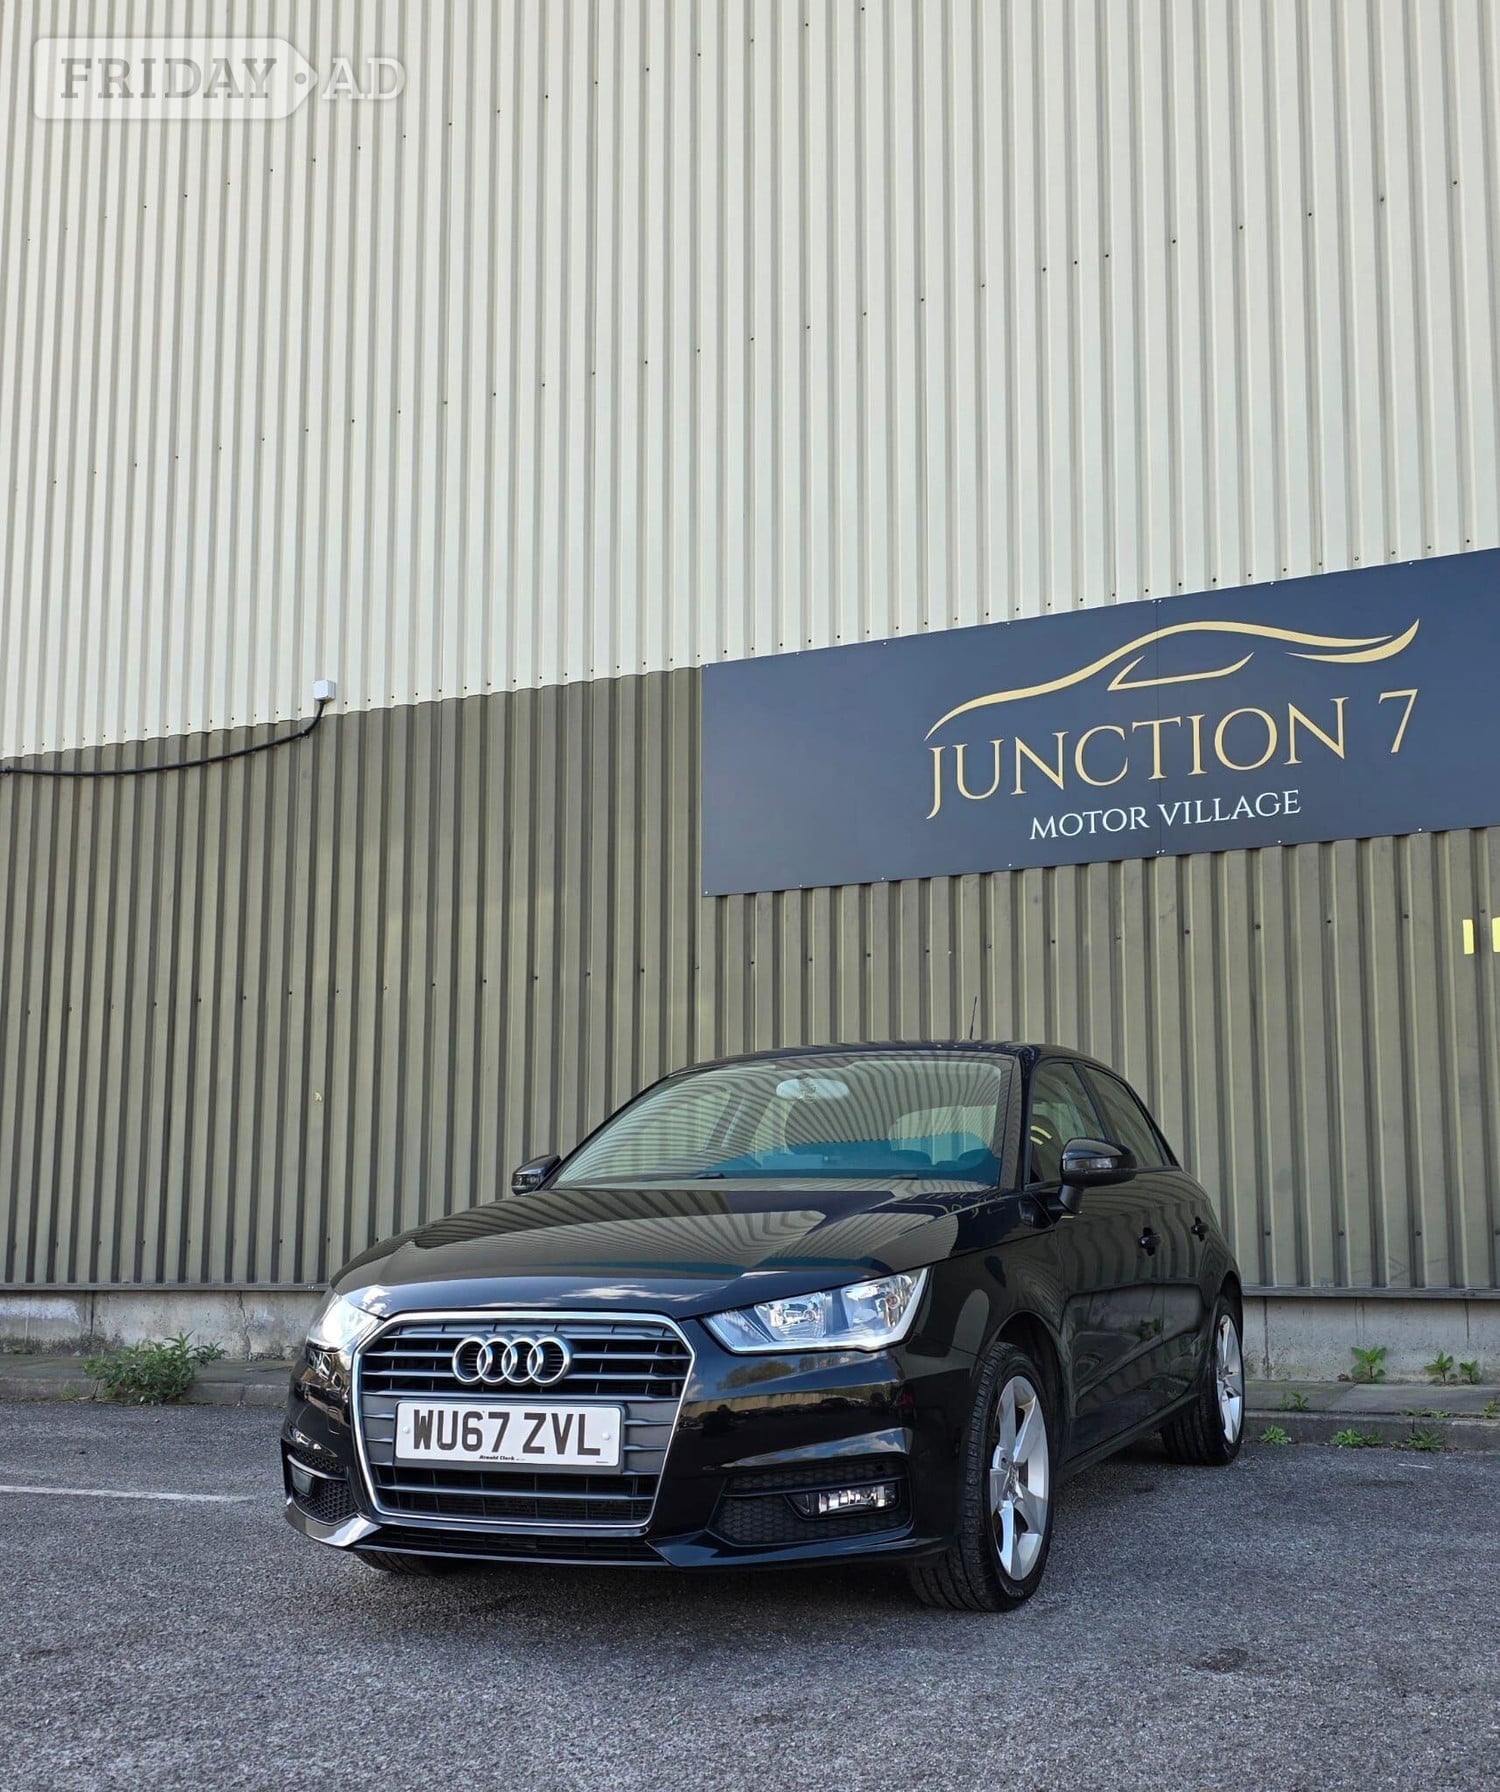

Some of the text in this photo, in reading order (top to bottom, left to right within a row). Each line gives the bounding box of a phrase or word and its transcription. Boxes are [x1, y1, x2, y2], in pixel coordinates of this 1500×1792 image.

[926, 688, 1418, 819] JUNCTION 7
[1029, 789, 1301, 840] MOTOR VILLAGE
[413, 1409, 601, 1456] WU67 ZVL
